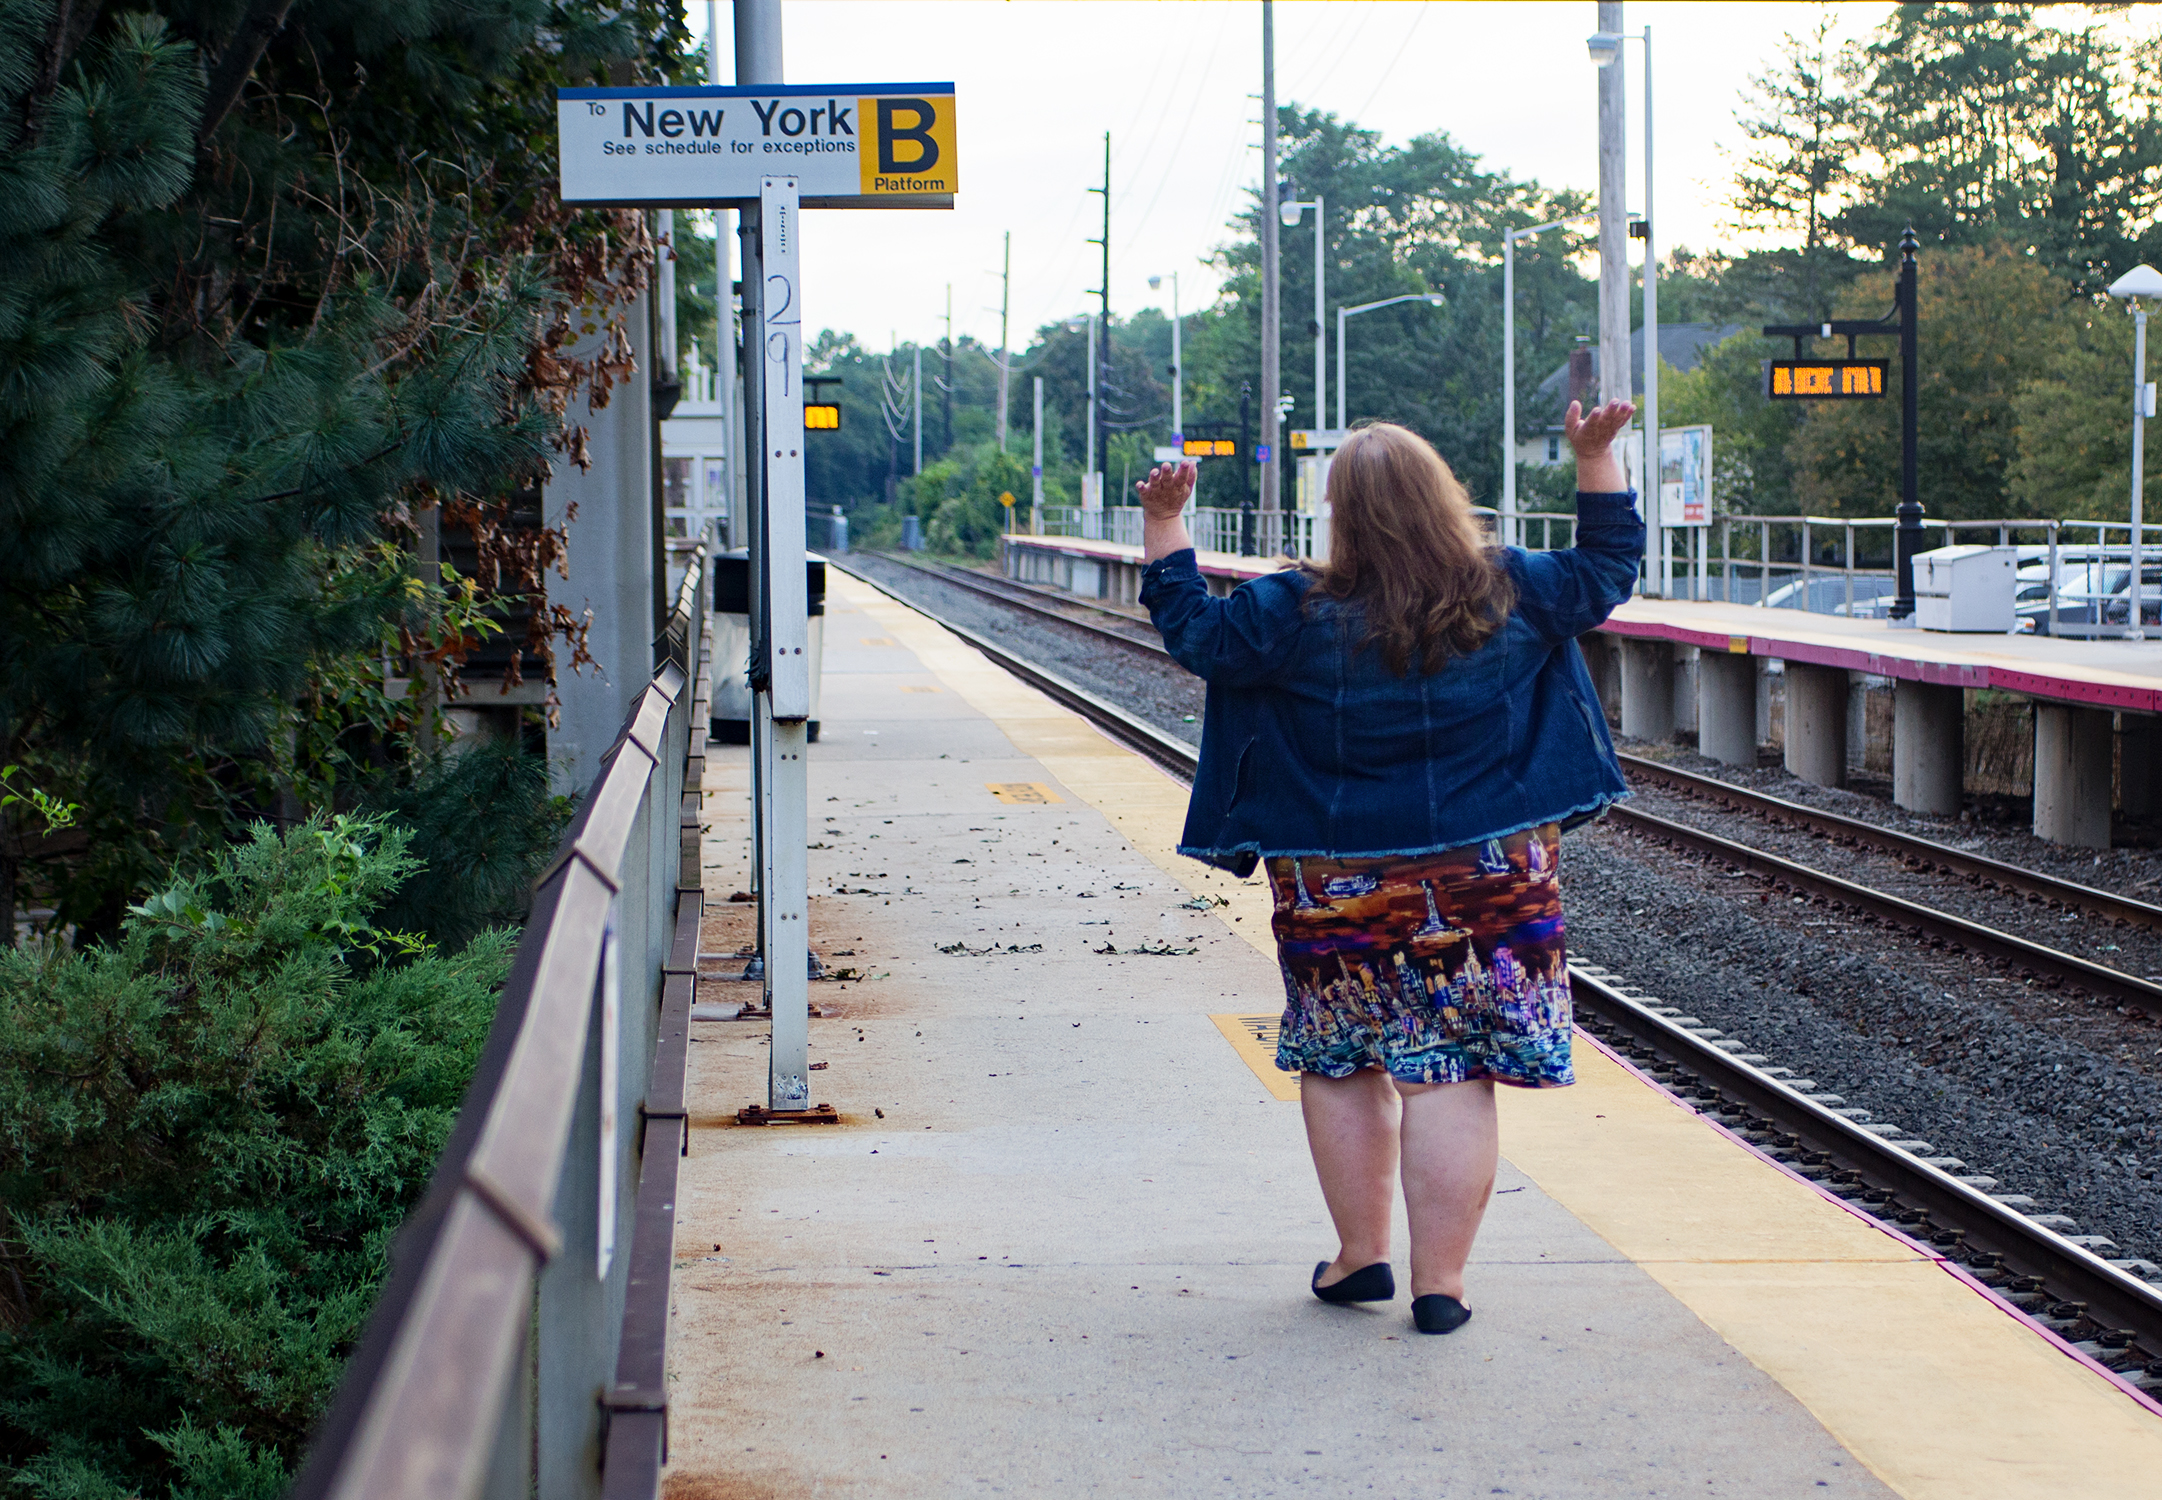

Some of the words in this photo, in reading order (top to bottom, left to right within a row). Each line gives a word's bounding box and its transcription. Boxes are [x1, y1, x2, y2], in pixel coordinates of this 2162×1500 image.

[586, 101, 606, 116] To
[623, 101, 724, 138] New
[749, 98, 855, 137] York
[603, 140, 637, 155] See
[645, 139, 722, 155] schedule
[730, 139, 755, 154] for
[763, 138, 856, 156] exceptions
[876, 98, 939, 173] B
[874, 176, 945, 192] Platform
